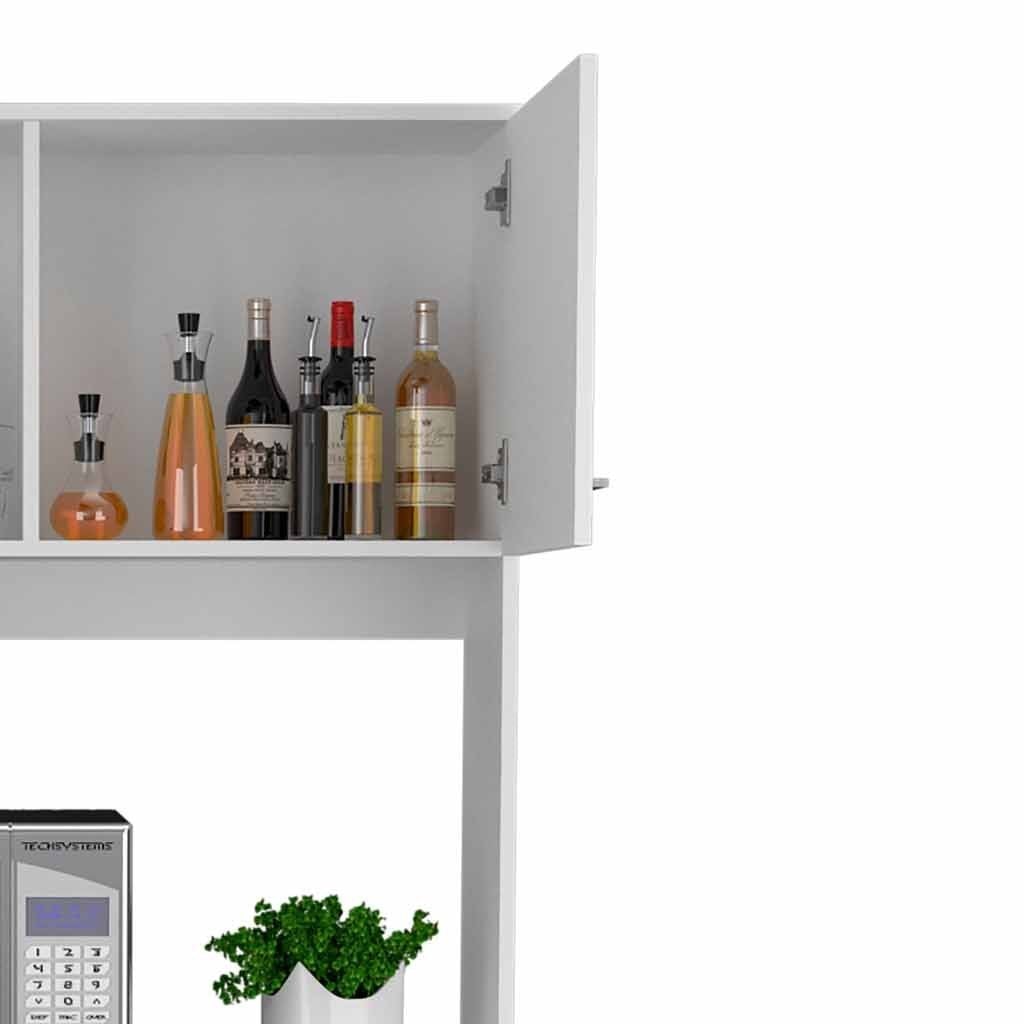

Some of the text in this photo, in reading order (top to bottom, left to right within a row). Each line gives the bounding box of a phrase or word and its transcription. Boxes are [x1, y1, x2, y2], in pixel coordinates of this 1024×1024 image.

[21, 841, 114, 851] TECHSYSTEMS
[35, 947, 102, 957] 1 2 3
[33, 964, 43, 973] 4
[64, 964, 74, 973] 5
[33, 980, 100, 989] 7 8 9
